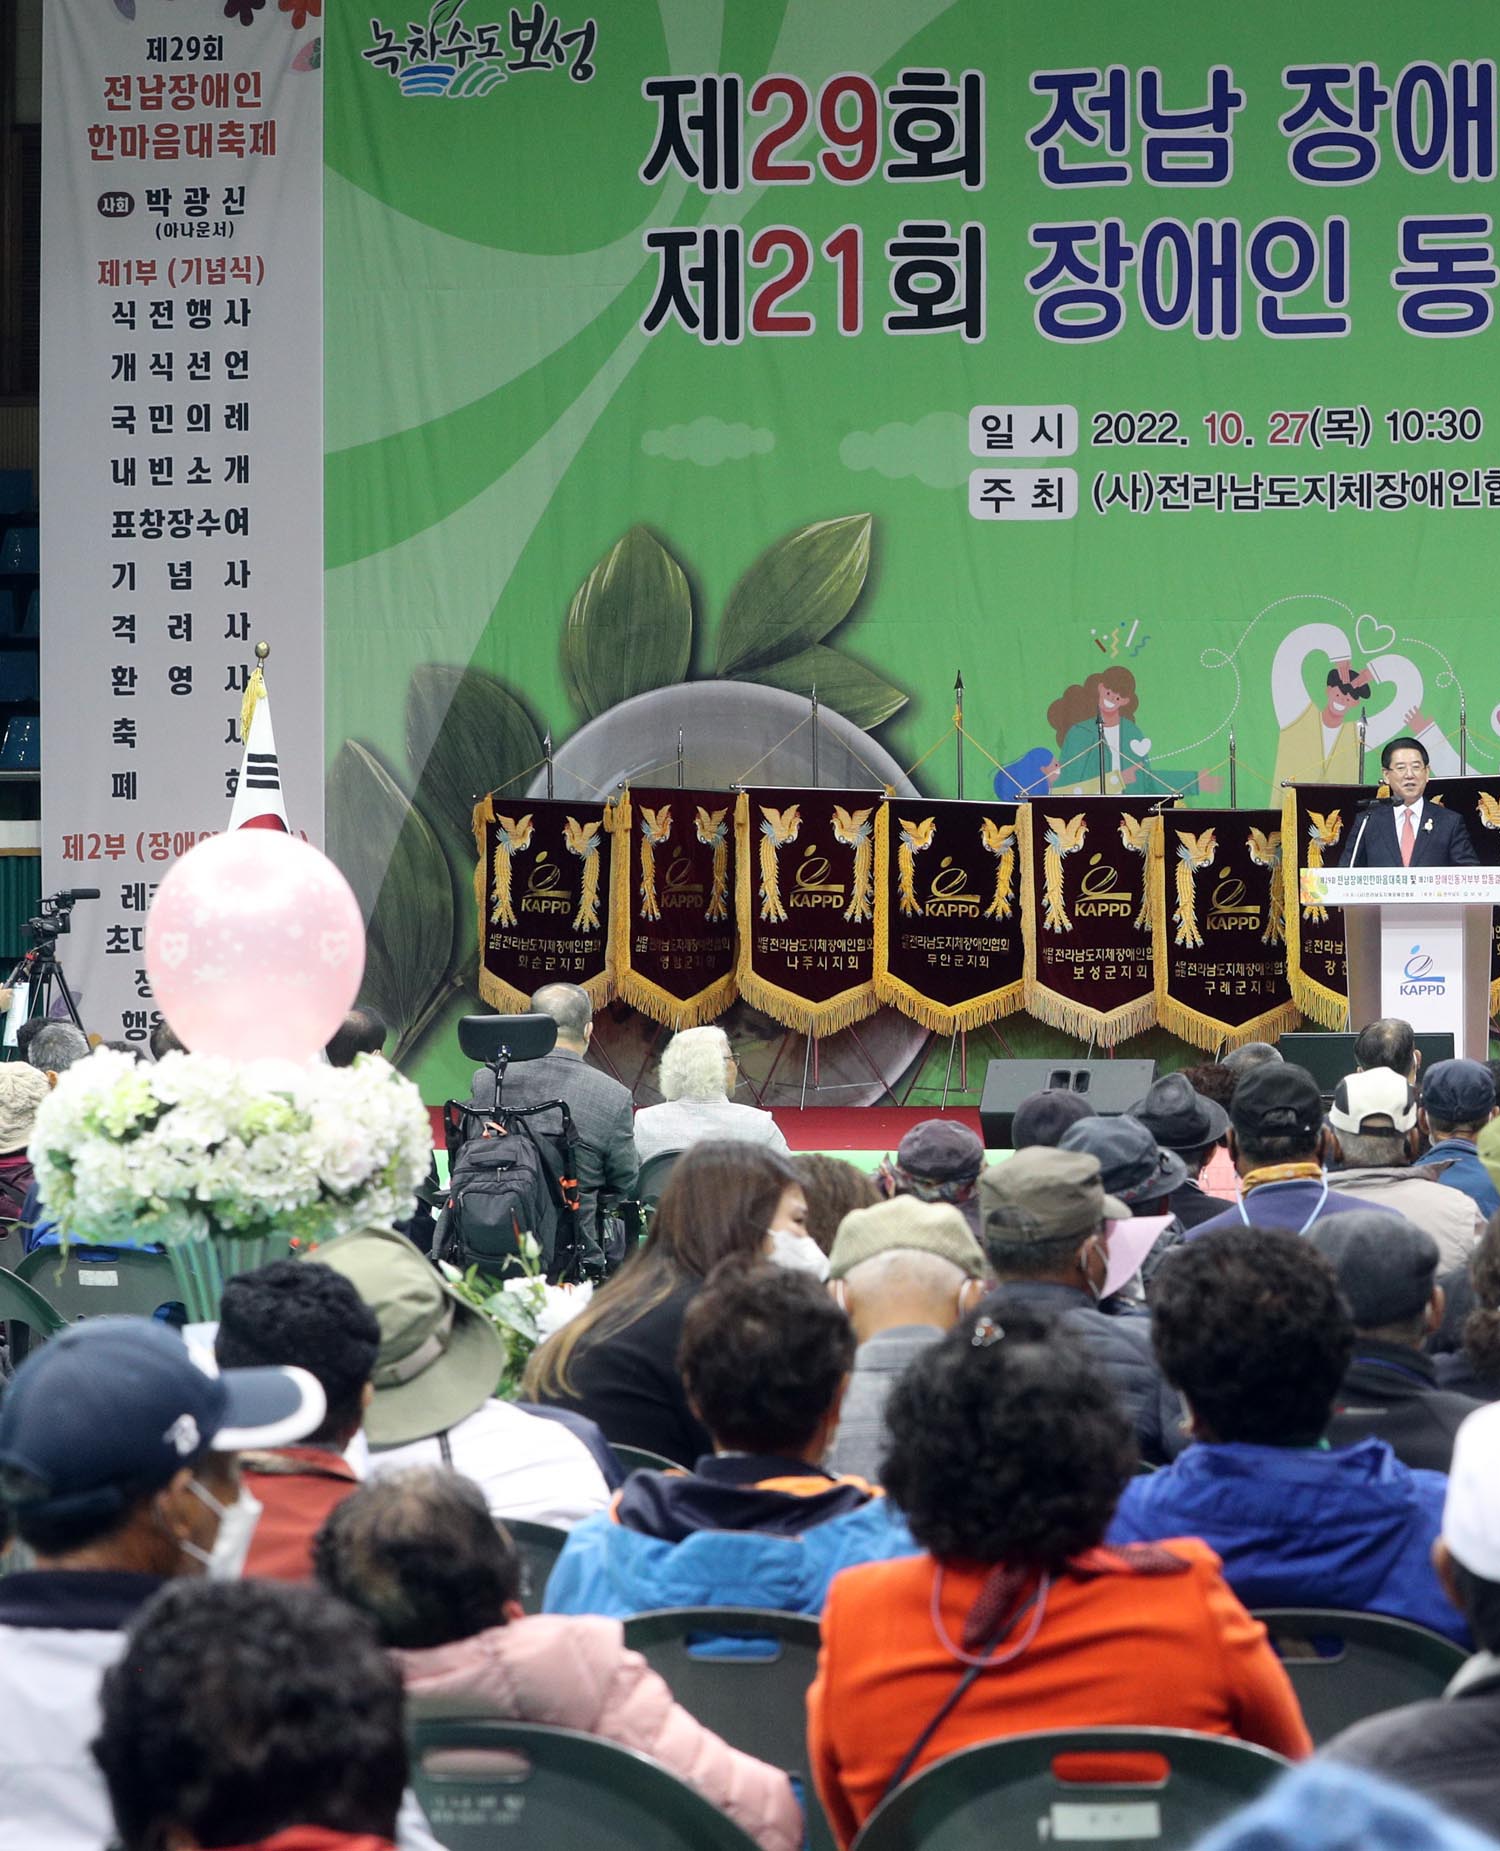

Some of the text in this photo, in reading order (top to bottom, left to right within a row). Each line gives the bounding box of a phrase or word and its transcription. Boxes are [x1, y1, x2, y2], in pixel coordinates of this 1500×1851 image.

[146, 34, 225, 62] 제29회
[363, 3, 596, 81] 녹차수도 보성
[103, 71, 262, 111] 전남장애인
[640, 69, 985, 192] 제29회
[1027, 64, 1244, 188] 전남
[87, 120, 277, 161] 한마음대축제
[101, 196, 131, 213] 사회
[155, 220, 235, 240] (아나운서)
[98, 255, 265, 287] 제1부 (기념식)
[641, 220, 985, 346] 제21회
[1026, 214, 1351, 341] 장애인
[1092, 412, 1189, 446] 2022.
[1204, 412, 1254, 446] 10.
[1268, 406, 1372, 447] 27(목)
[1385, 408, 1483, 442] 10:30
[111, 508, 250, 539] 표창장수여
[62, 833, 126, 862] 제2부
[521, 897, 572, 915] KAPPD
[661, 893, 704, 908] KAPPD
[790, 894, 844, 909] KAPPD
[925, 903, 980, 918] KAPPD
[1075, 902, 1132, 917] KAPPD
[1206, 916, 1261, 931] KAPPD
[1054, 947, 1153, 963] 전라남도지체장애인협
[1399, 985, 1446, 996] KAPPD
